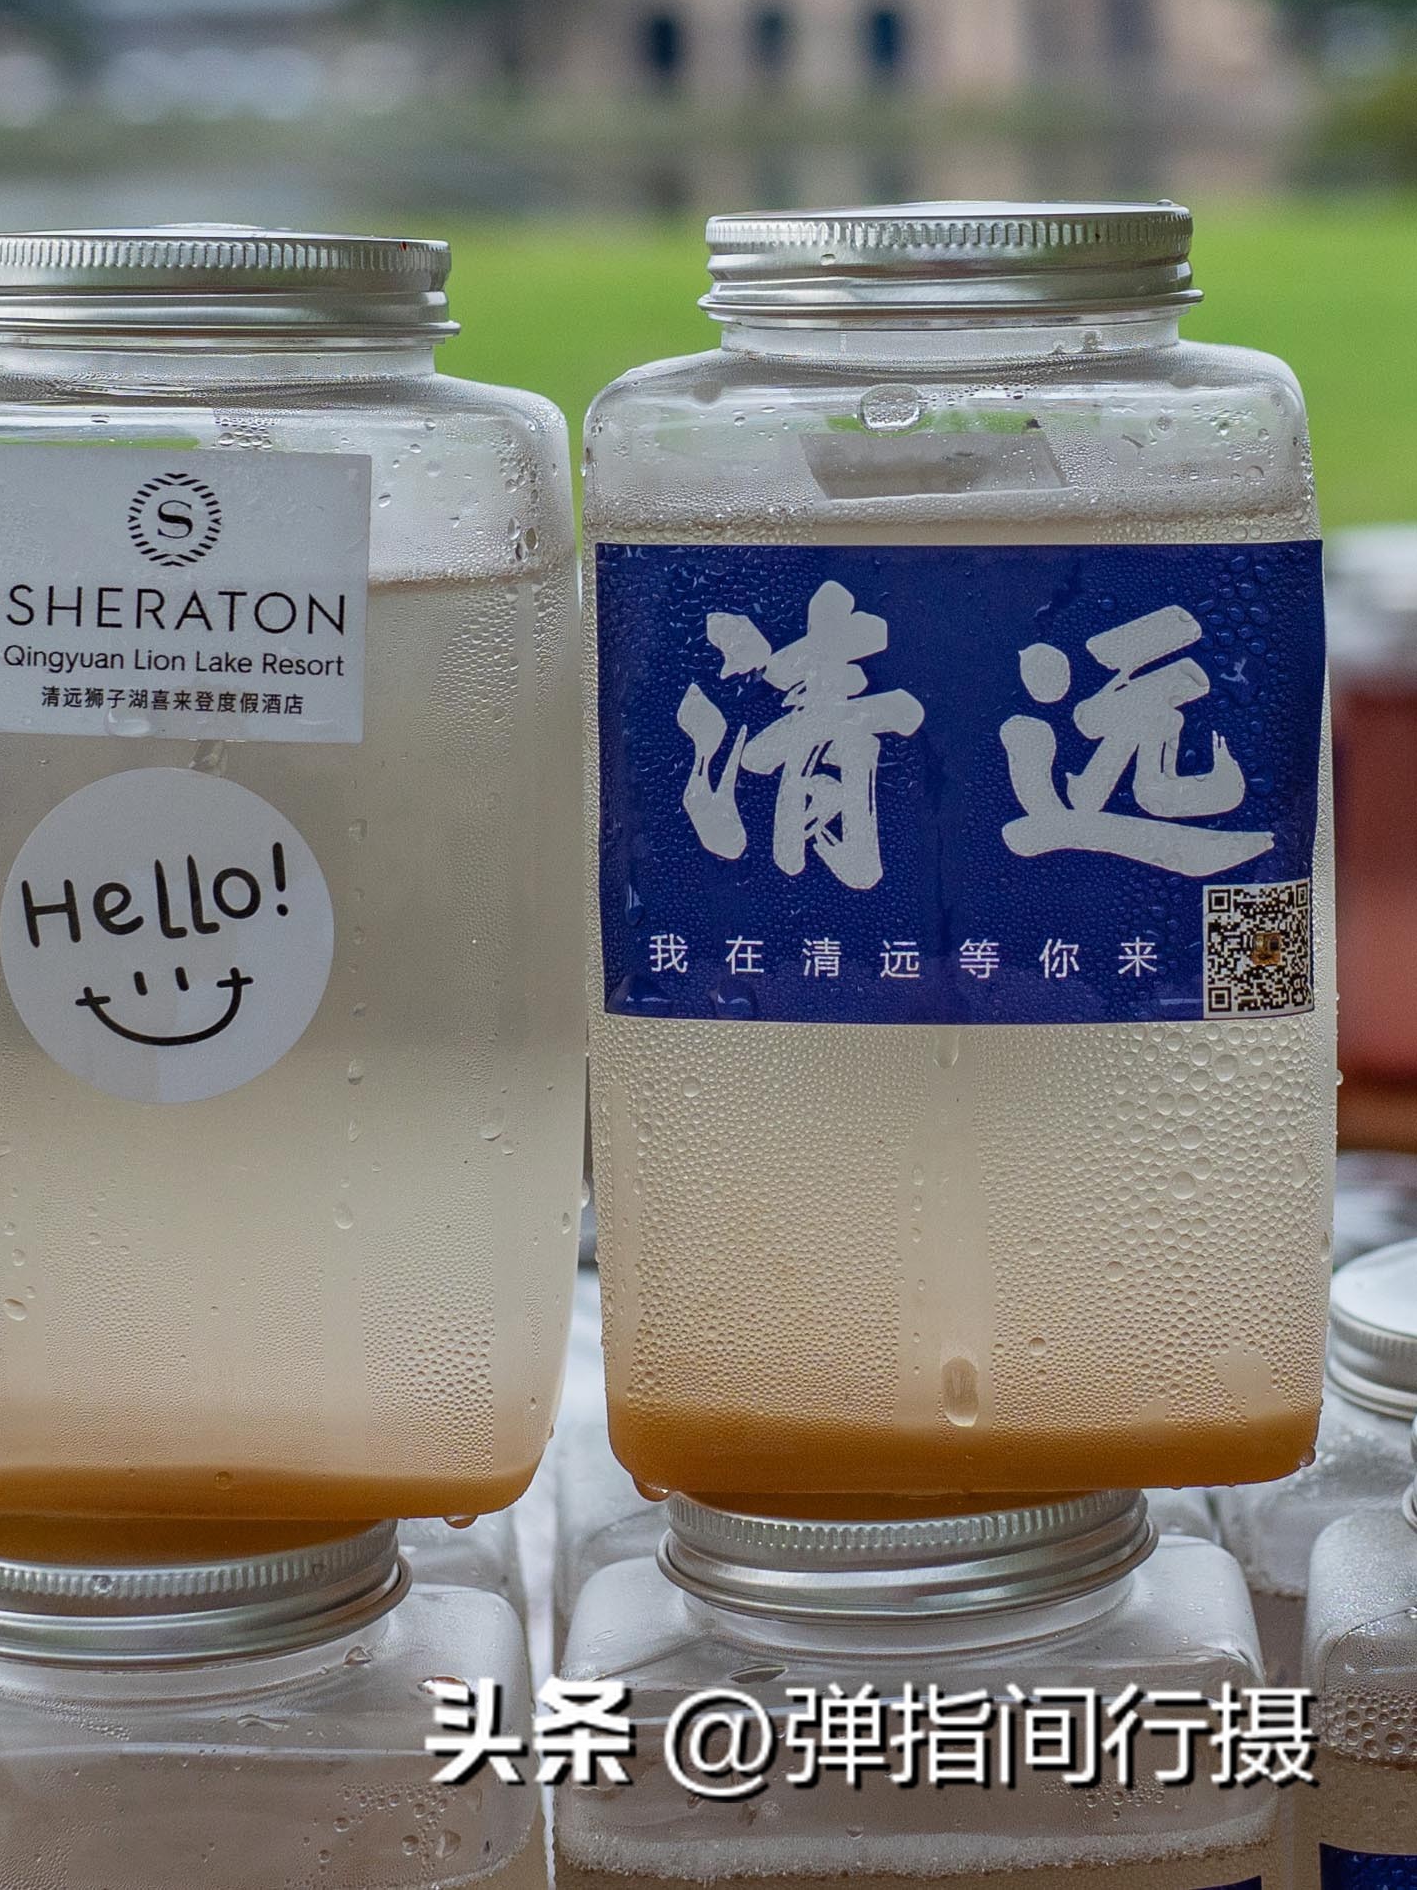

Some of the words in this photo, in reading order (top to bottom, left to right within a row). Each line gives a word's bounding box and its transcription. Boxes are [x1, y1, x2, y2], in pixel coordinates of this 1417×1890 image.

[156, 499, 194, 540] S
[5, 583, 346, 636] SHERATON
[3, 644, 124, 675] Qingyuan
[134, 648, 186, 671] Lion
[196, 651, 253, 674] Lake
[263, 653, 345, 677] Resort
[40, 685, 304, 716] 清远狮子湖喜来登度假酒店
[677, 580, 1275, 891] 清远
[21, 842, 289, 949] Hello!
[648, 935, 1159, 981] 我在清远等你来
